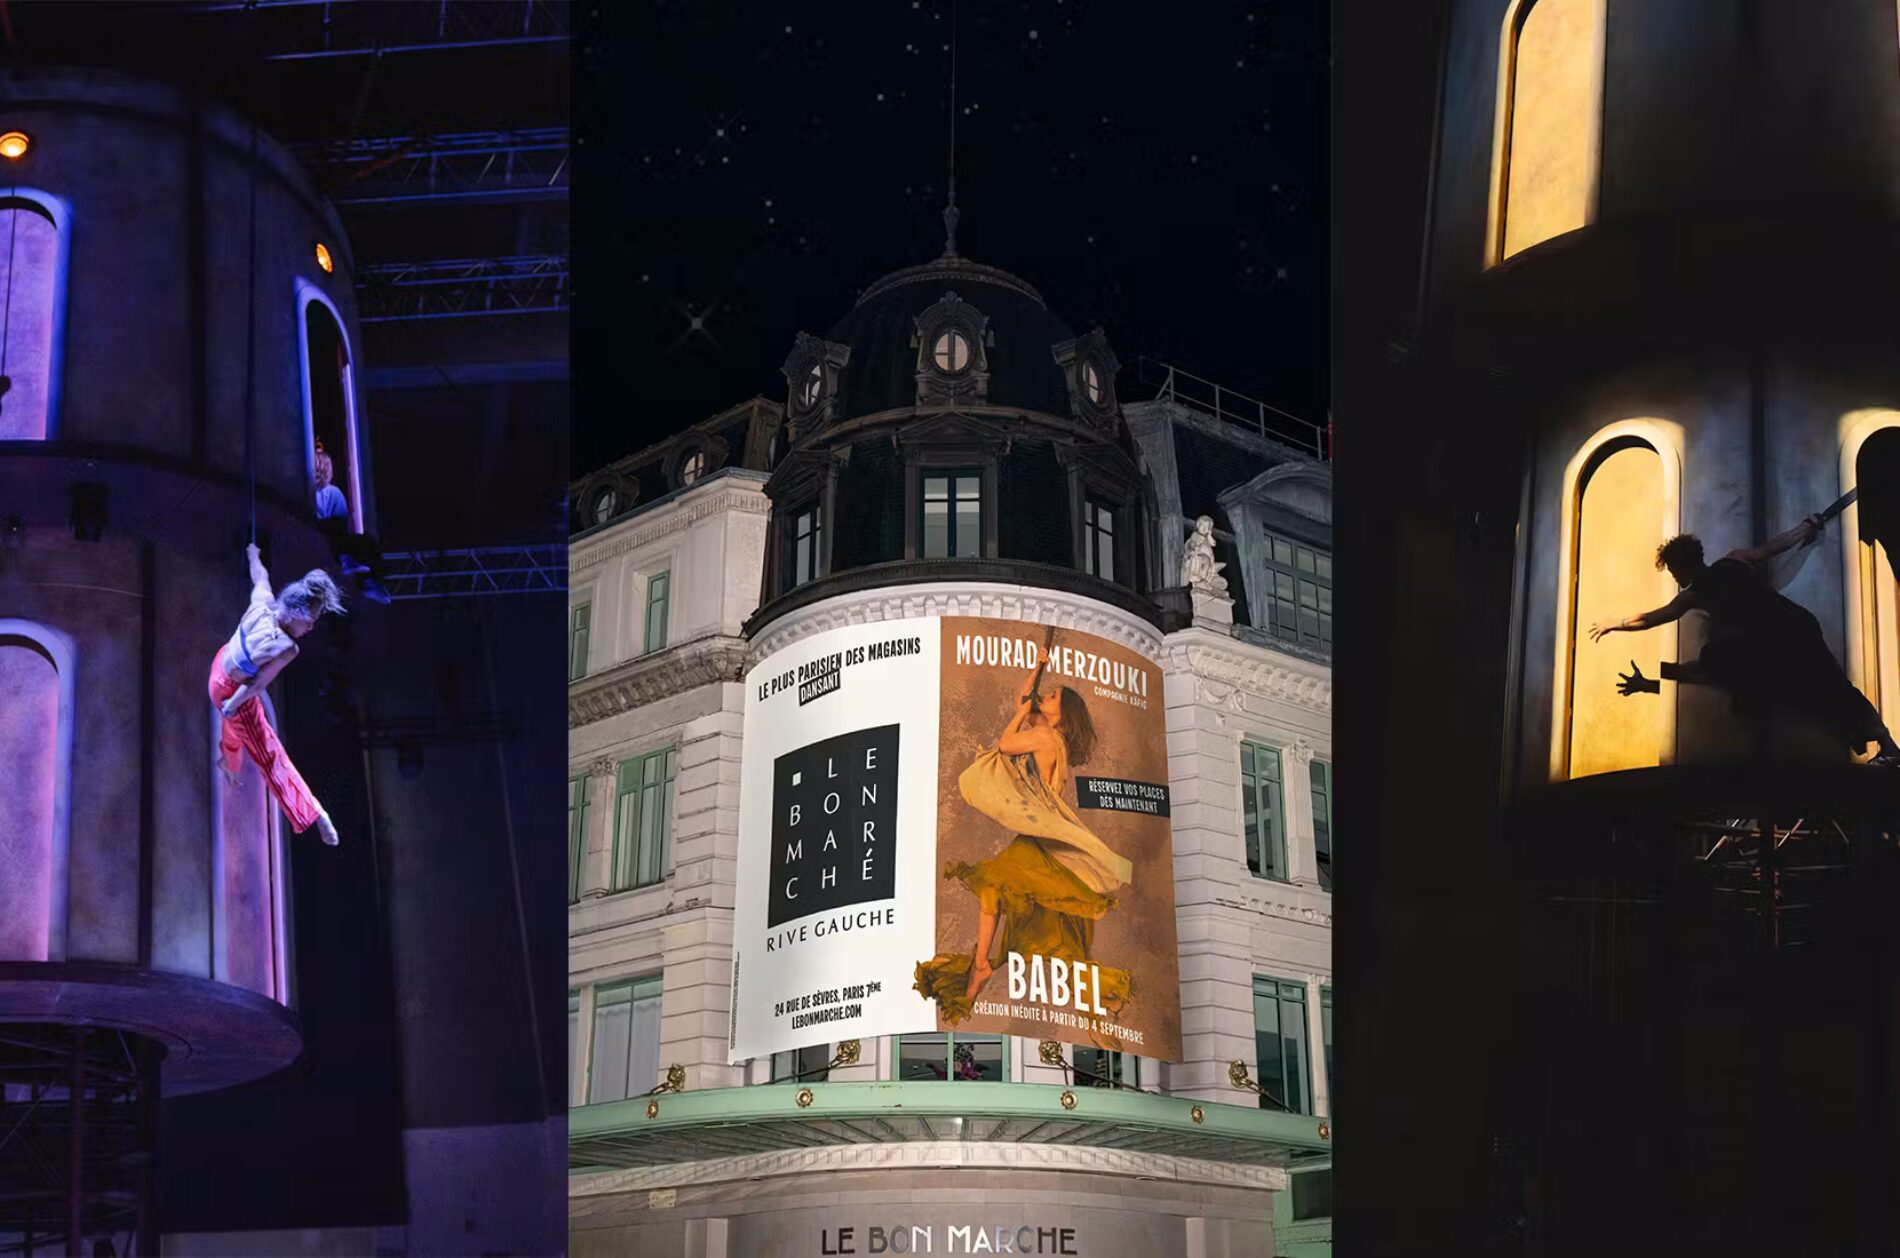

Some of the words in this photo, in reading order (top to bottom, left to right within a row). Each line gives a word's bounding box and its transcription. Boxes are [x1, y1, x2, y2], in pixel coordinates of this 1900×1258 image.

[759, 682, 769, 701] LE
[771, 670, 795, 695] PLUS
[798, 652, 842, 682] PARISIEN
[846, 647, 864, 667] DES
[868, 637, 921, 662] MAGASINS
[956, 635, 1038, 669] MOURAD
[1046, 645, 1147, 697] MERZOUKI
[800, 671, 840, 702] DANSANT
[1088, 779, 1122, 794] RÉSERVEZ
[1123, 783, 1138, 797] VOS
[1139, 785, 1165, 800] PLACES
[1115, 797, 1158, 813] MAINTENANT
[767, 925, 807, 952] RIVE
[814, 909, 895, 937] GAUCHE
[1008, 951, 1107, 1017] BABEL
[775, 1002, 784, 1017] 24
[786, 997, 800, 1013] RUE
[801, 995, 811, 1010] DE
[843, 985, 865, 1001] PARIS
[792, 1004, 862, 1030] LEBONMARCHE.COM
[974, 1001, 1009, 1017] CRÉATION
[1011, 1003, 1040, 1021] INÉDITE
[1042, 1005, 1048, 1021] À
[1050, 1011, 1077, 1027] PARTIR
[1078, 1017, 1090, 1031] DU
[1091, 1020, 1098, 1032] 4
[1100, 1022, 1144, 1045] SEPTEMBRE
[822, 1227, 856, 1255] LE
[868, 1226, 932, 1254] BON
[948, 1225, 1078, 1256] MARCHE
